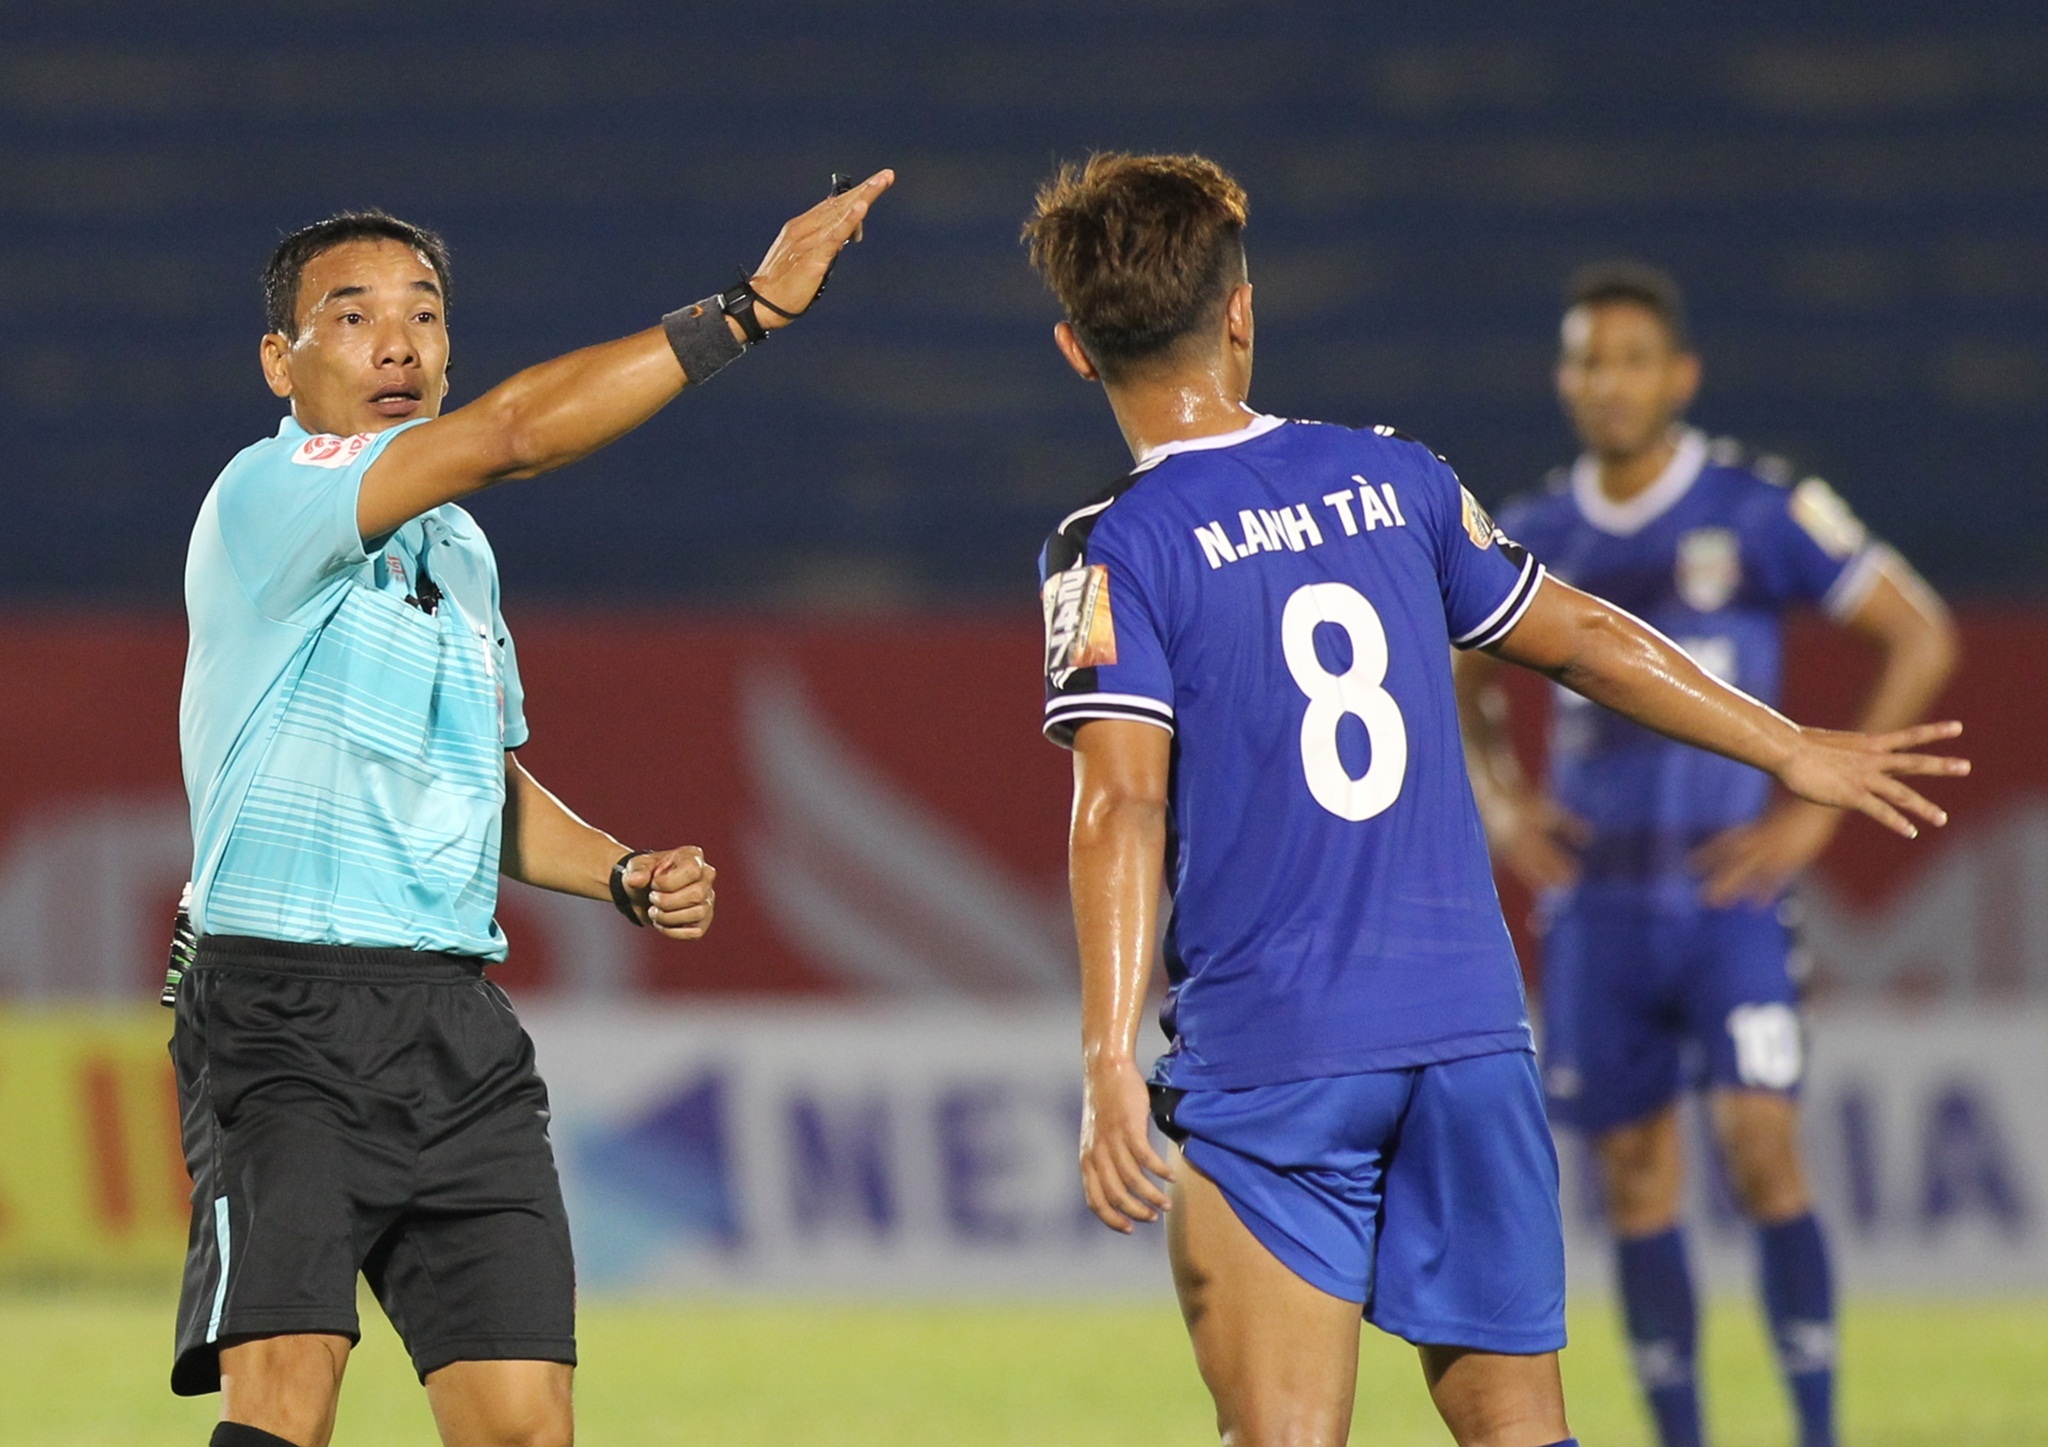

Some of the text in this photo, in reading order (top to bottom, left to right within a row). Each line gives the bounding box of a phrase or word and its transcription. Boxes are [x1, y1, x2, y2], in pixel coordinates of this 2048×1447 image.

[1194, 503, 1324, 570] N.ANH
[1322, 474, 1407, 537] TÀI
[1281, 582, 1408, 822] 8
